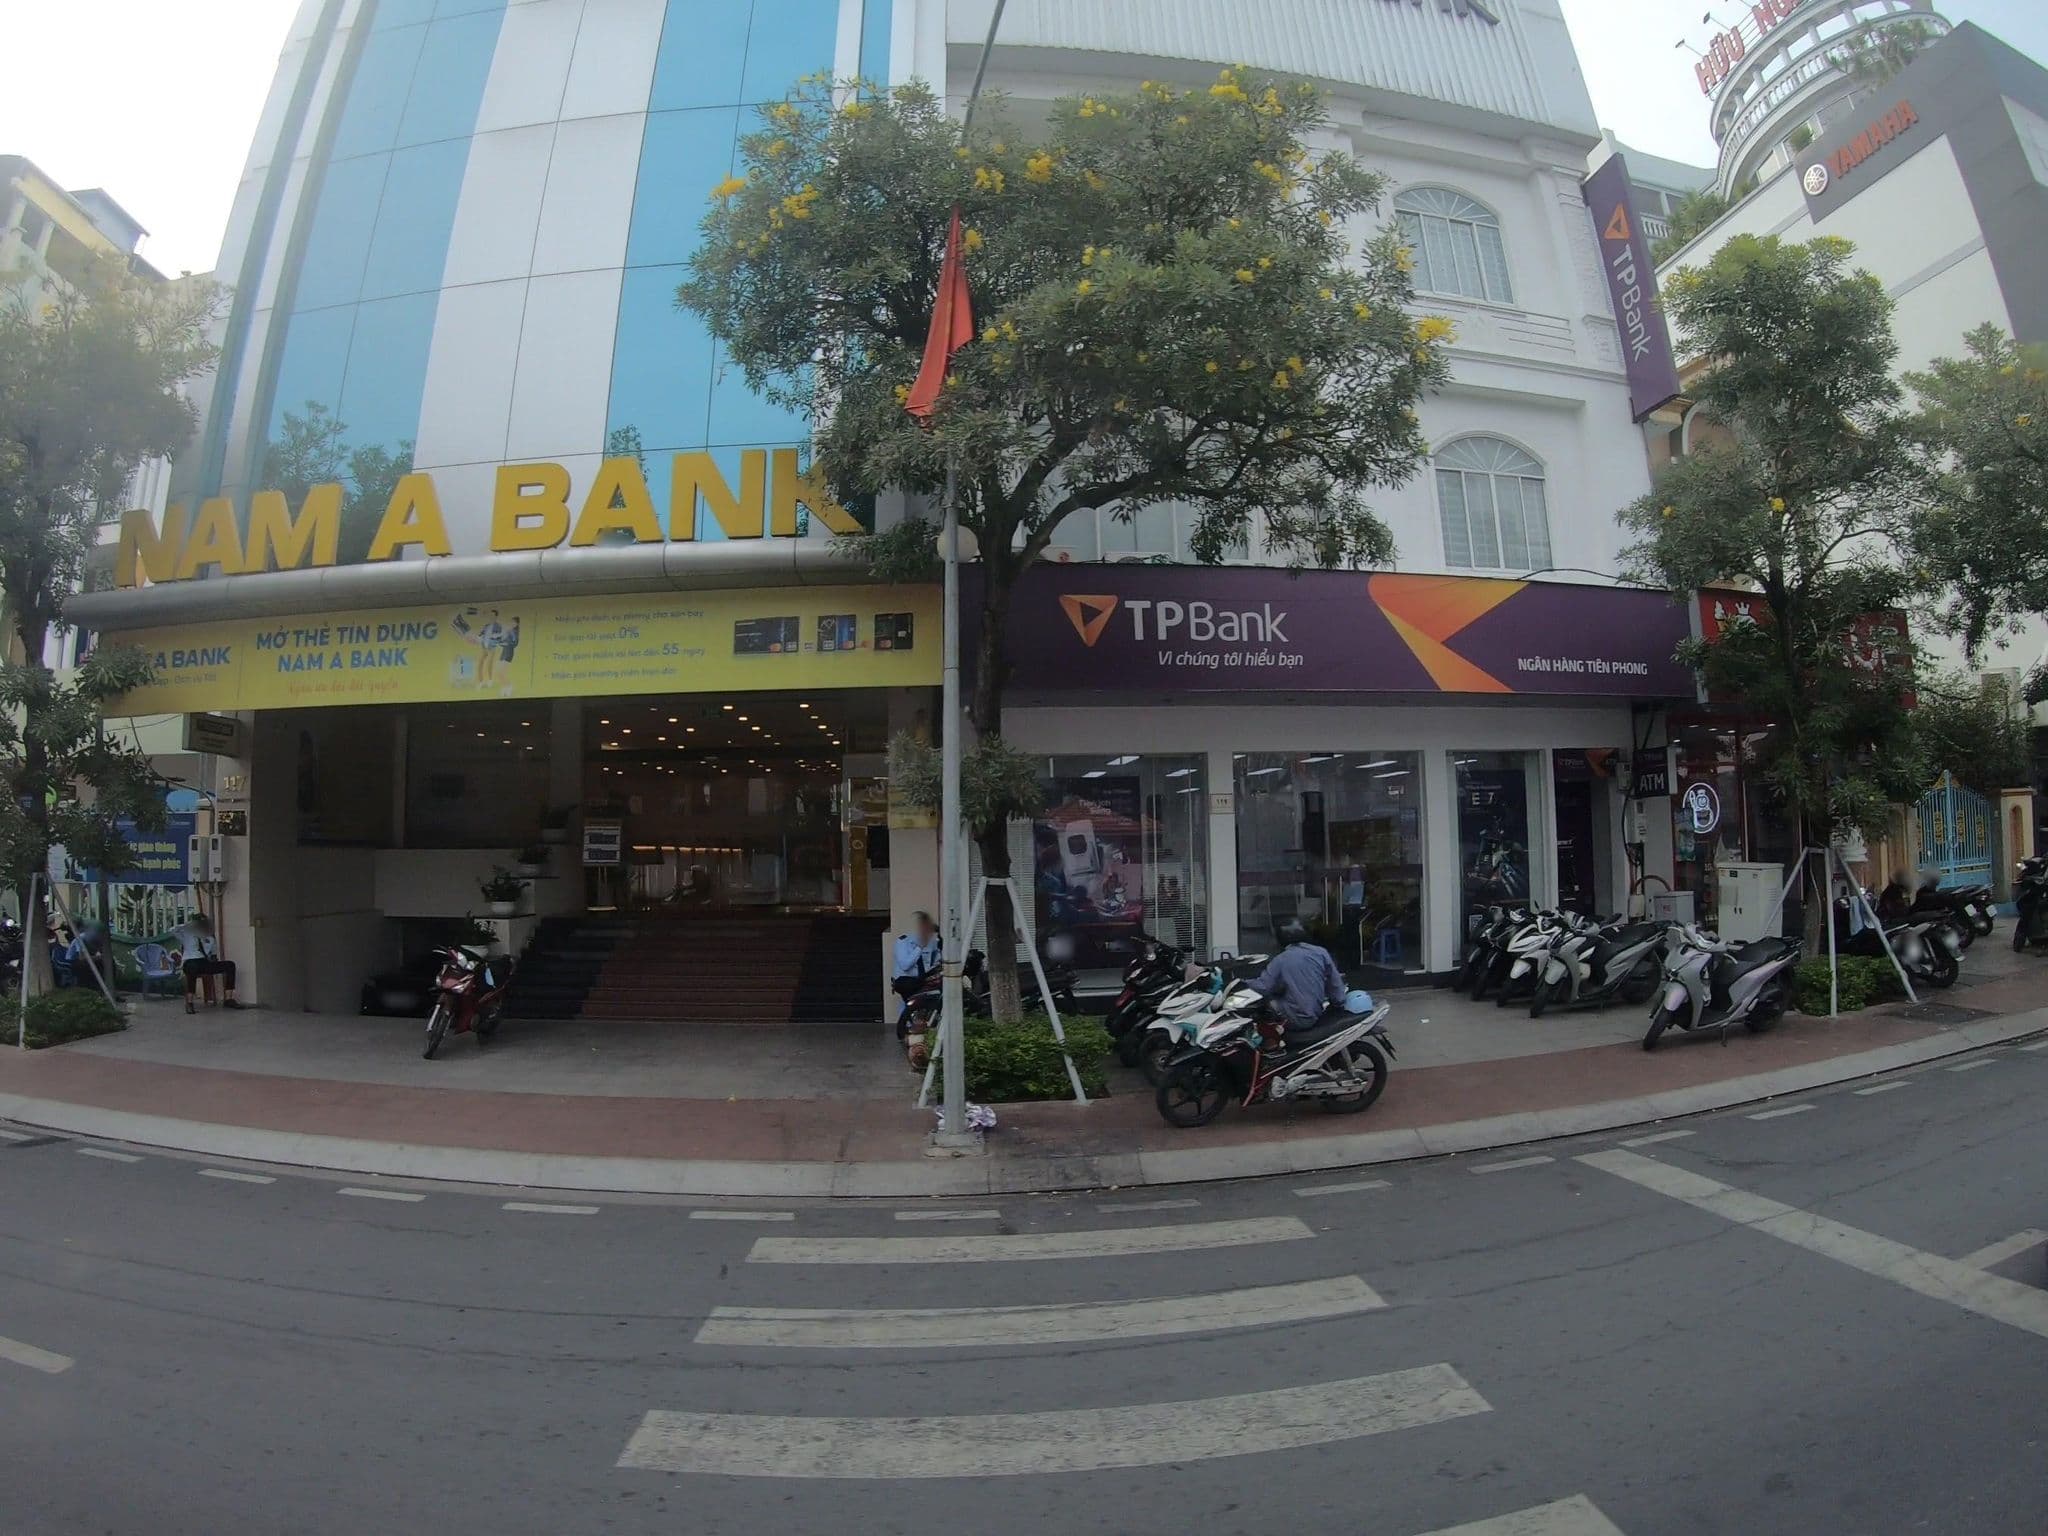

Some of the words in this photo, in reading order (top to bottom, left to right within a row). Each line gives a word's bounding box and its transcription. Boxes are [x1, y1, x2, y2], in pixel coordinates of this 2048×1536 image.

[1827, 98, 1919, 180] YAMAHA
[1613, 243, 1651, 362] TPBank
[114, 482, 344, 588] NAM
[367, 473, 453, 561] A
[490, 448, 865, 552] BANK
[1125, 600, 1289, 642] TPBank
[256, 625, 289, 650] MỞ
[293, 622, 330, 647] THẺ
[337, 621, 369, 645] TÍN
[377, 621, 438, 646] DỤNG
[172, 646, 231, 668] BANK
[278, 652, 324, 673] NAM
[351, 648, 409, 668] BANK
[662, 643, 680, 656] 55
[1176, 651, 1220, 669] chúng
[1224, 652, 1242, 666] tôi
[1245, 648, 1275, 666] hiểu
[1279, 652, 1304, 669] bạn
[1518, 656, 1550, 671] NGÂN
[1553, 657, 1584, 673] HÀNG
[1586, 658, 1610, 674] TIÊN
[1612, 662, 1648, 675] PHONG
[1640, 773, 1664, 792] ATM
